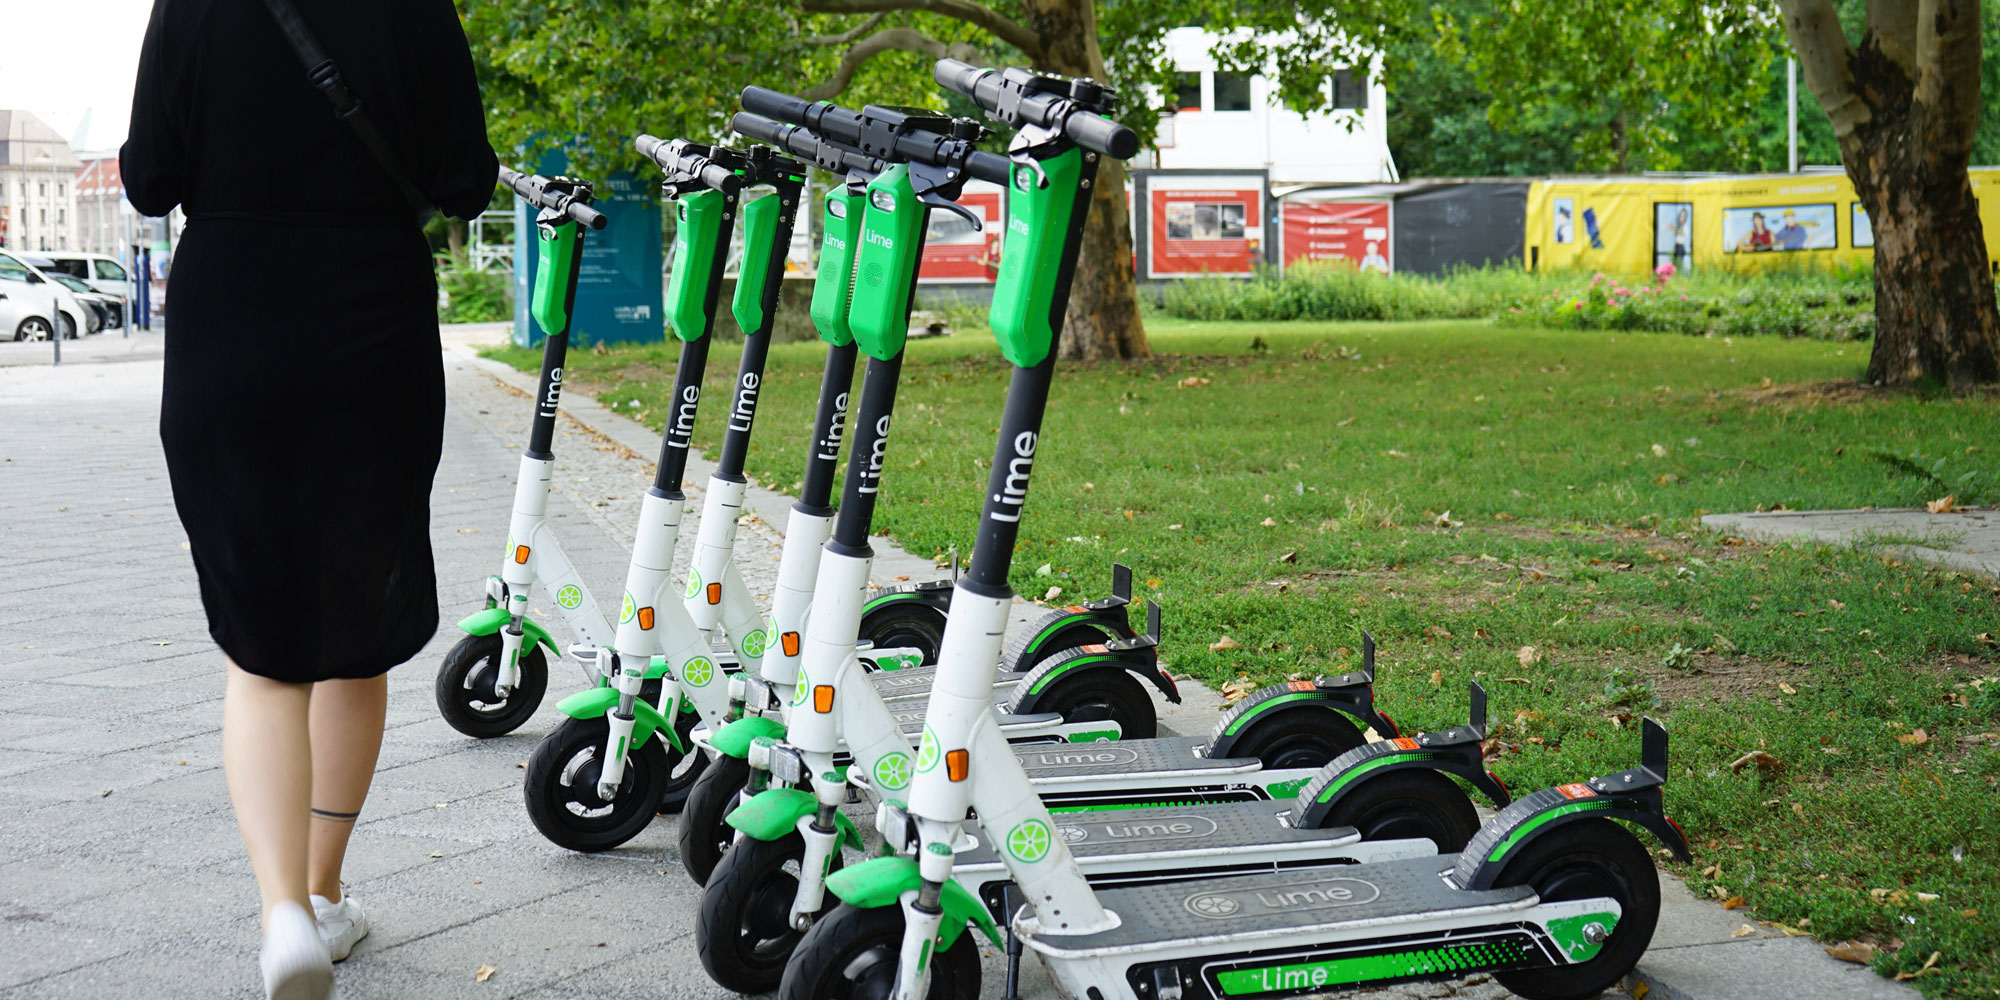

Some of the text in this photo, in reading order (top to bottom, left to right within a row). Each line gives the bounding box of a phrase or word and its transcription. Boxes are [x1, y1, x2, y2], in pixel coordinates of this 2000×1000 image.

[1009, 212, 1030, 236] Lime
[824, 232, 846, 250] Lime
[865, 228, 894, 249] Lime
[540, 367, 564, 418] Lime
[729, 371, 759, 433] Lime
[667, 384, 700, 449] Lime
[818, 391, 850, 461] Lime
[858, 414, 892, 494] Lime
[990, 430, 1038, 523] Lime
[1040, 753, 1116, 765] Lime
[1105, 822, 1193, 838] Lime
[1256, 886, 1354, 908] Lime
[1262, 966, 1328, 992] Lime
